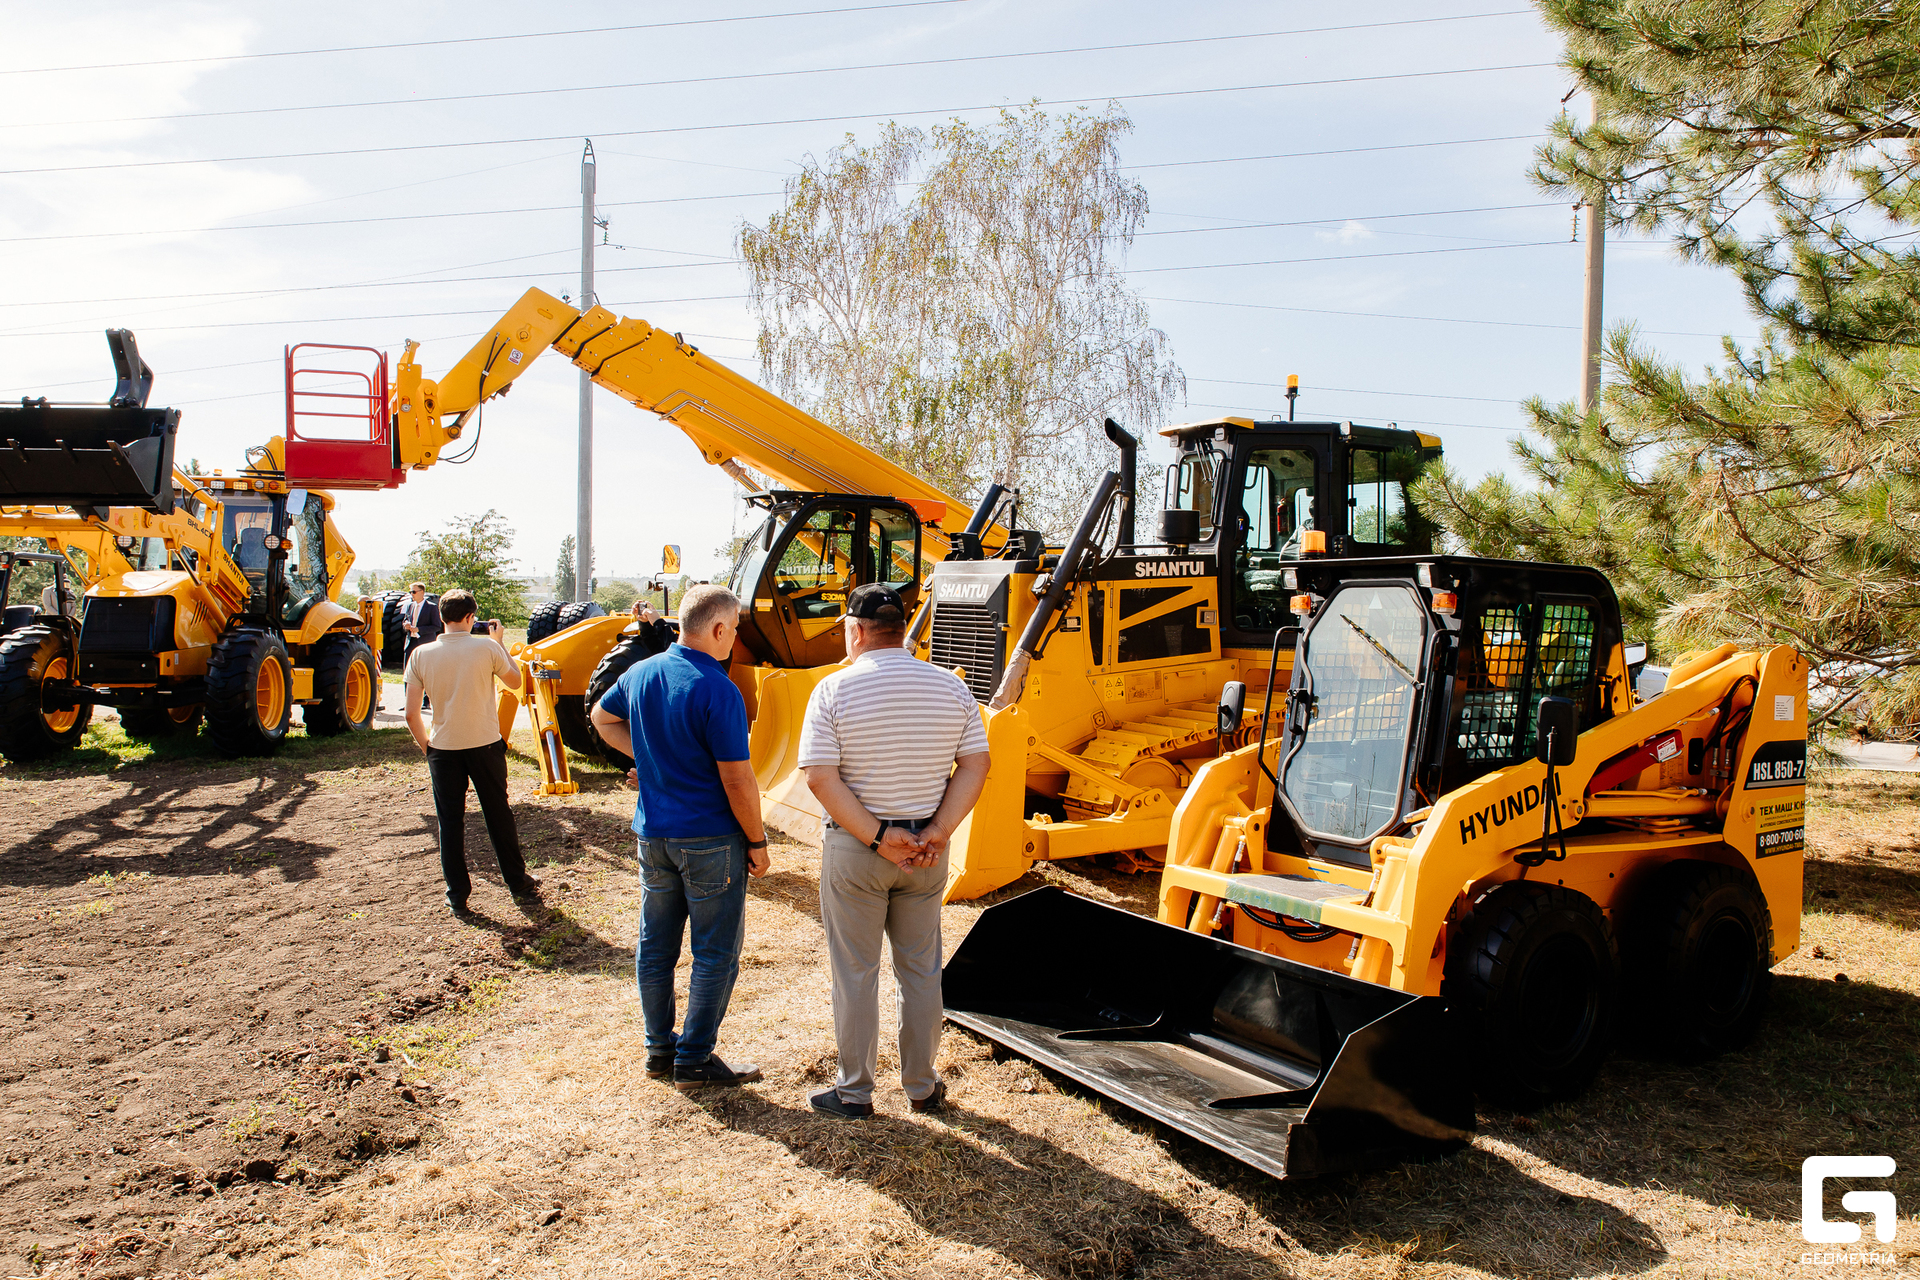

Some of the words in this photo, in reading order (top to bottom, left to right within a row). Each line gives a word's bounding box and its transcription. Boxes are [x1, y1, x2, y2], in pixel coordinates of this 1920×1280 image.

[187, 517, 200, 532] BHL
[223, 554, 245, 585] SHANTUI
[1135, 561, 1205, 578] SHANTUI
[939, 582, 990, 599] SHANTUI
[1753, 762, 1774, 781] HSL
[1774, 760, 1806, 779] 850-7
